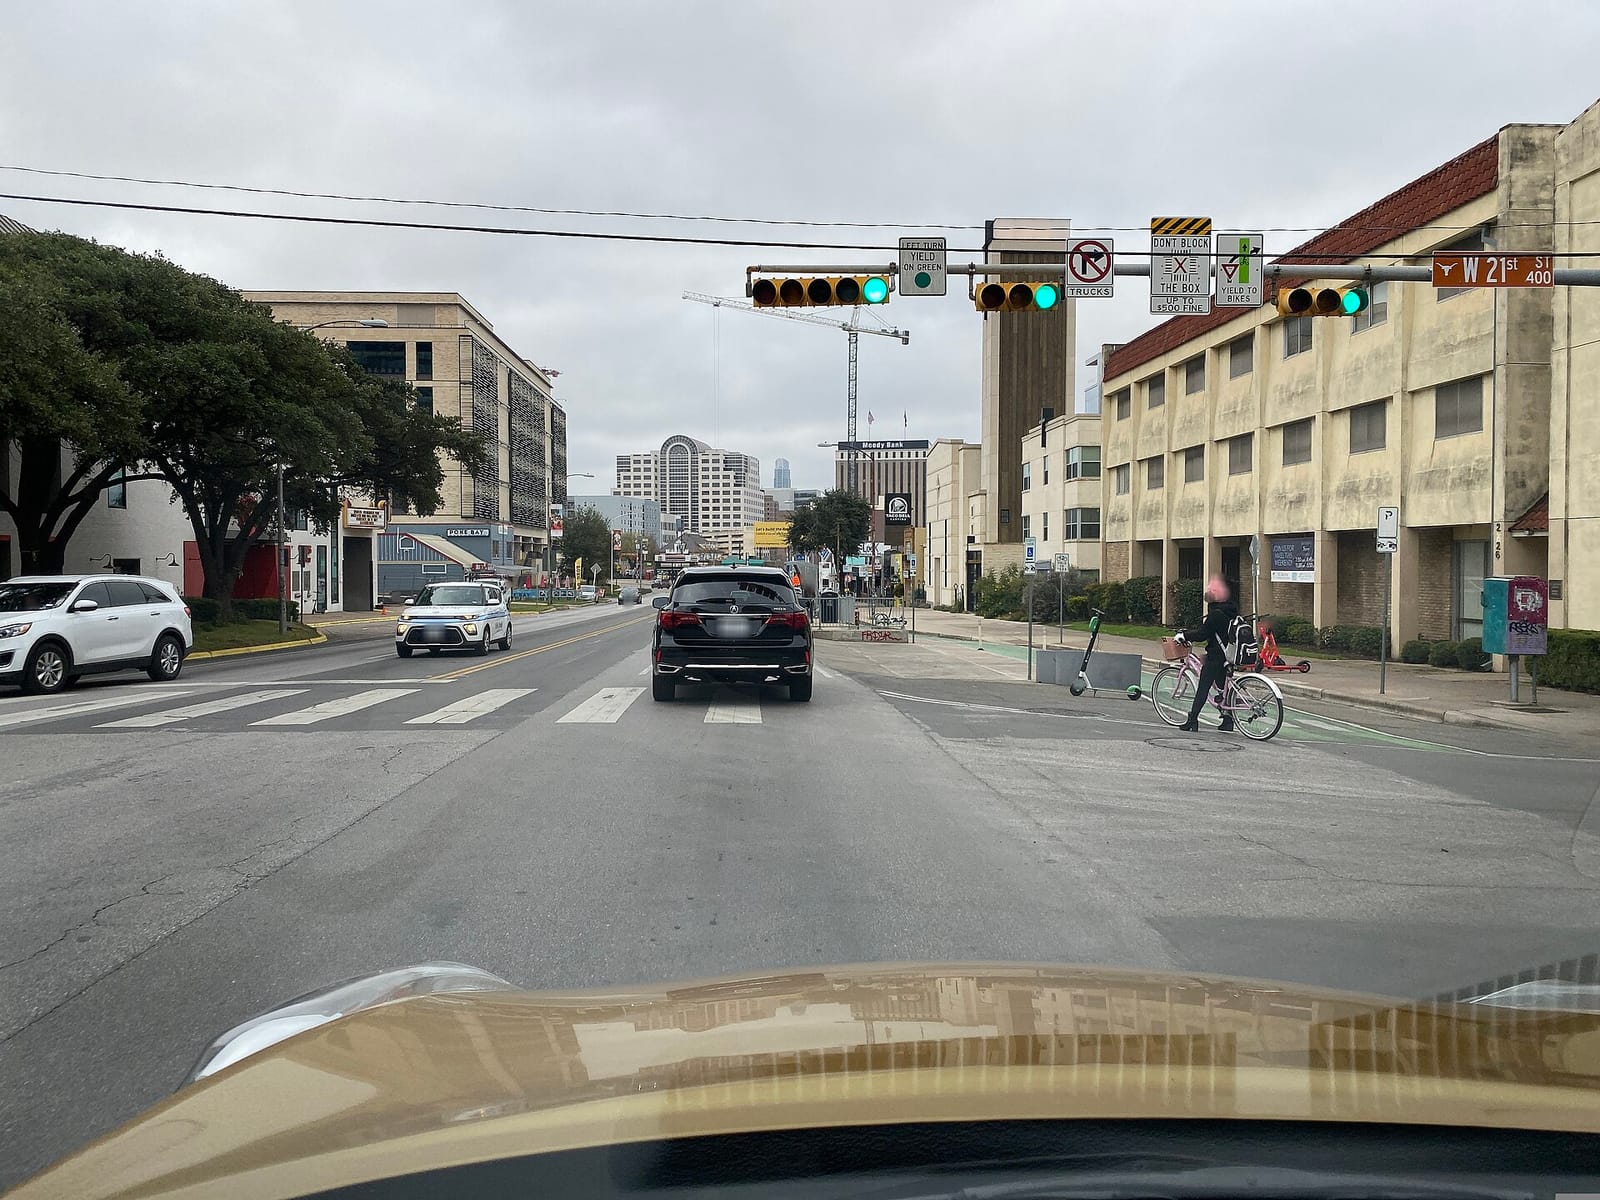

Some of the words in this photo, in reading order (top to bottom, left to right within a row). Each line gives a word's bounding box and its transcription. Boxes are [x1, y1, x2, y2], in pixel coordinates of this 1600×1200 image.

[1181, 238, 1209, 248] BLOCK
[910, 252, 935, 261] YIELD
[903, 263, 914, 271] ON
[917, 263, 942, 271] GREEN
[1462, 256, 1479, 283] W
[1486, 256, 1518, 283] 21st
[1535, 256, 1550, 269] ST
[1526, 270, 1551, 284] 400
[1070, 288, 1110, 296] TRUCKS
[1160, 283, 1178, 293] THE
[1182, 283, 1201, 293] BOX
[1166, 297, 1179, 305] UP
[1183, 297, 1194, 305] TO
[1227, 295, 1251, 303] BIKES
[1157, 304, 1180, 312] $500
[1183, 304, 1203, 312] FINE
